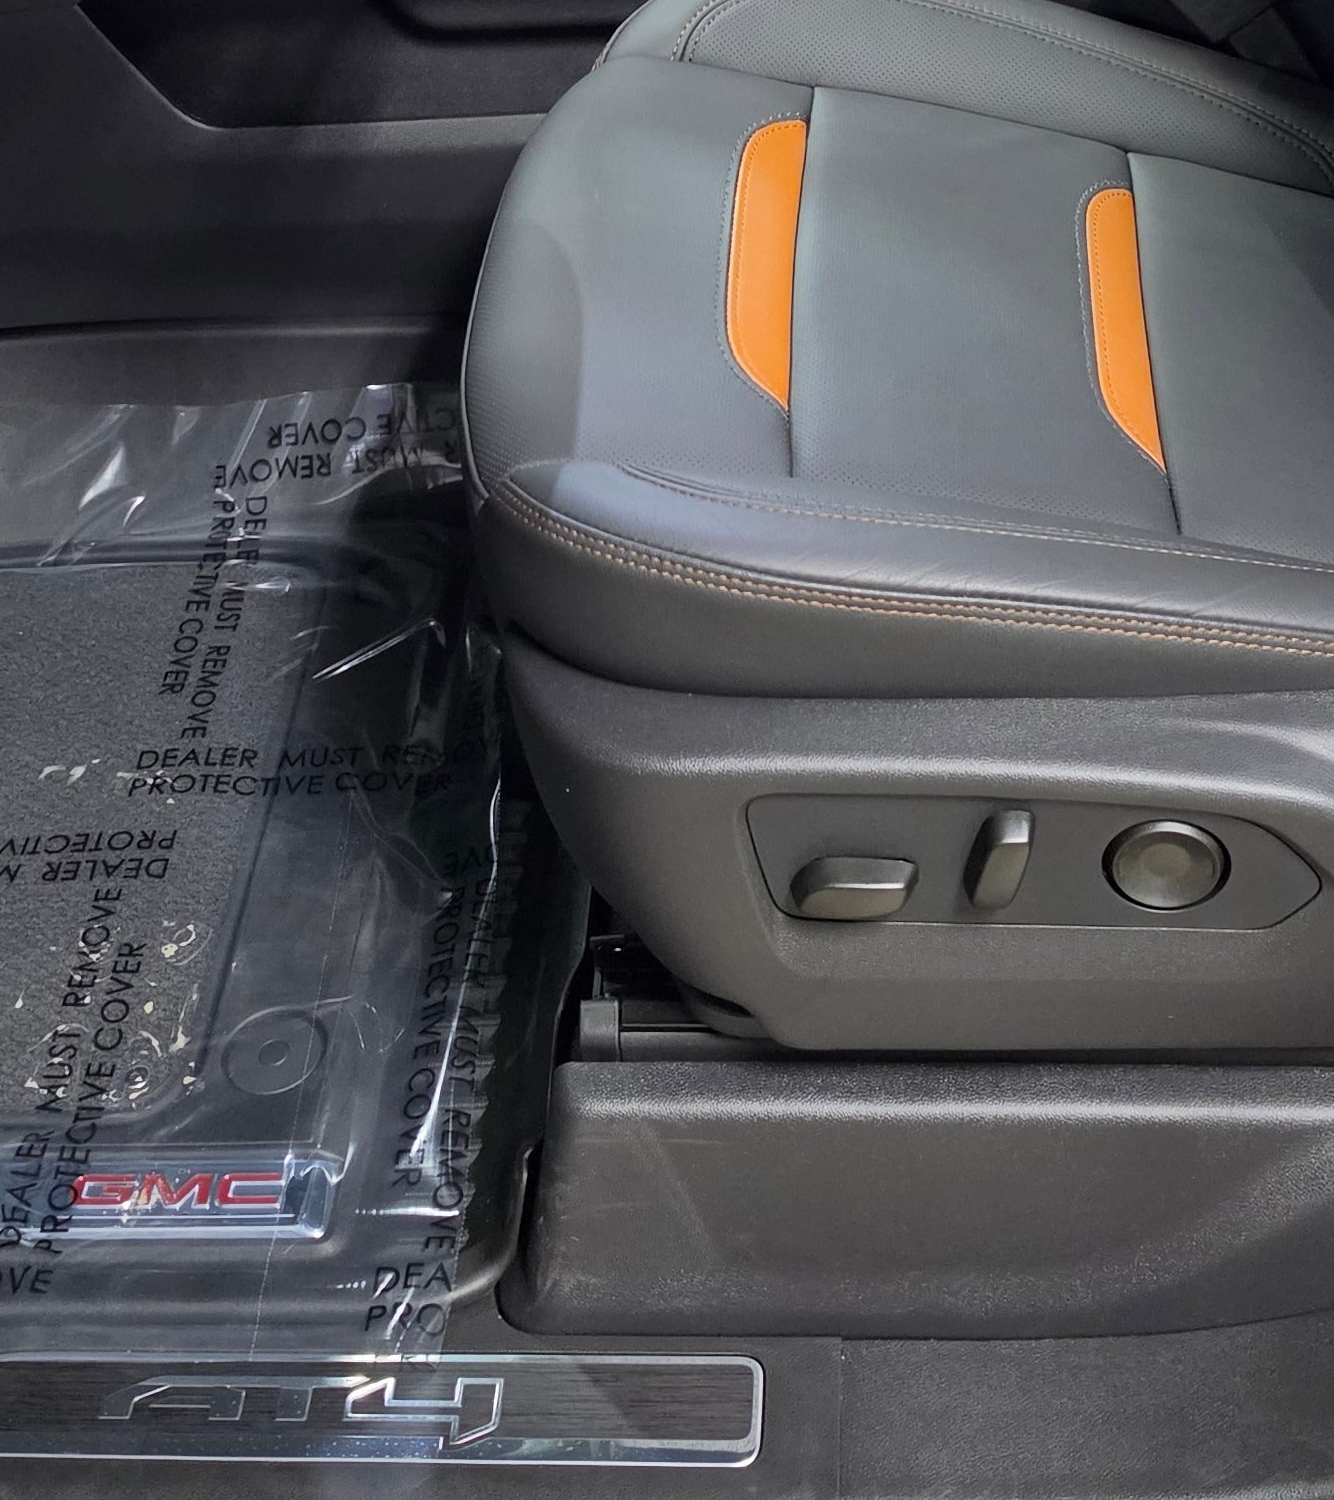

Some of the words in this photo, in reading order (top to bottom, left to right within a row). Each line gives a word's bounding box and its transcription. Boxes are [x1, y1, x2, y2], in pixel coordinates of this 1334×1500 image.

[267, 417, 367, 449] COVER
[213, 452, 332, 490] REMOVE
[163, 617, 204, 695] COVER
[181, 643, 232, 739] REMOVE
[127, 773, 324, 798] PROTECTIVE
[335, 771, 452, 794] COVER
[136, 748, 259, 771] DEALER
[278, 746, 362, 770] MUST
[41, 857, 170, 882] DEALER
[61, 885, 124, 1009] REMOVE
[413, 886, 466, 1060] PROTECTIVE
[31, 1056, 119, 1257] PROTECTIVE
[92, 941, 147, 1053] COVER
[71, 1172, 285, 1210] GMC
[422, 1108, 471, 1253] REMOVE
[97, 1376, 504, 1447] AT4
